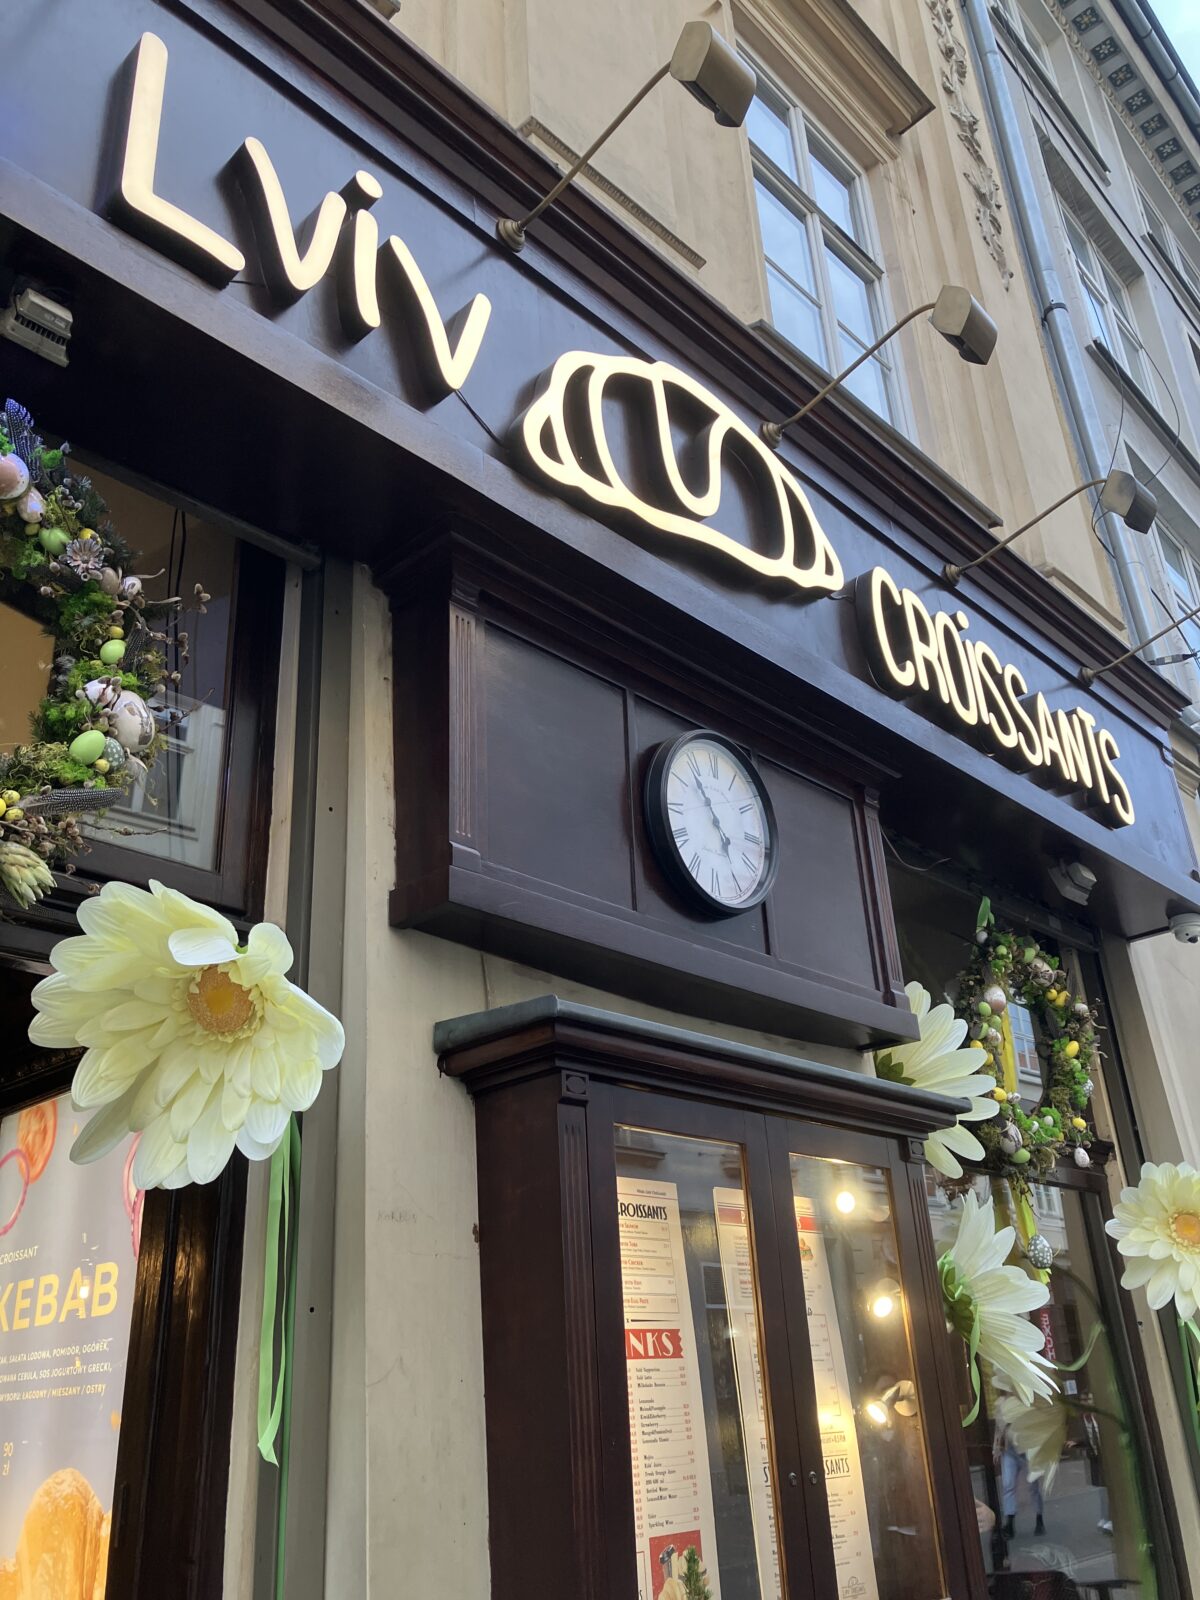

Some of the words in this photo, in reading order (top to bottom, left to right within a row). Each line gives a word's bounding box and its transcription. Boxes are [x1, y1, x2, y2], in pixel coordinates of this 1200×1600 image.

[121, 32, 491, 390] Lviv
[618, 1202, 668, 1221] ROISSANTS
[0, 1262, 119, 1332] KEBAB
